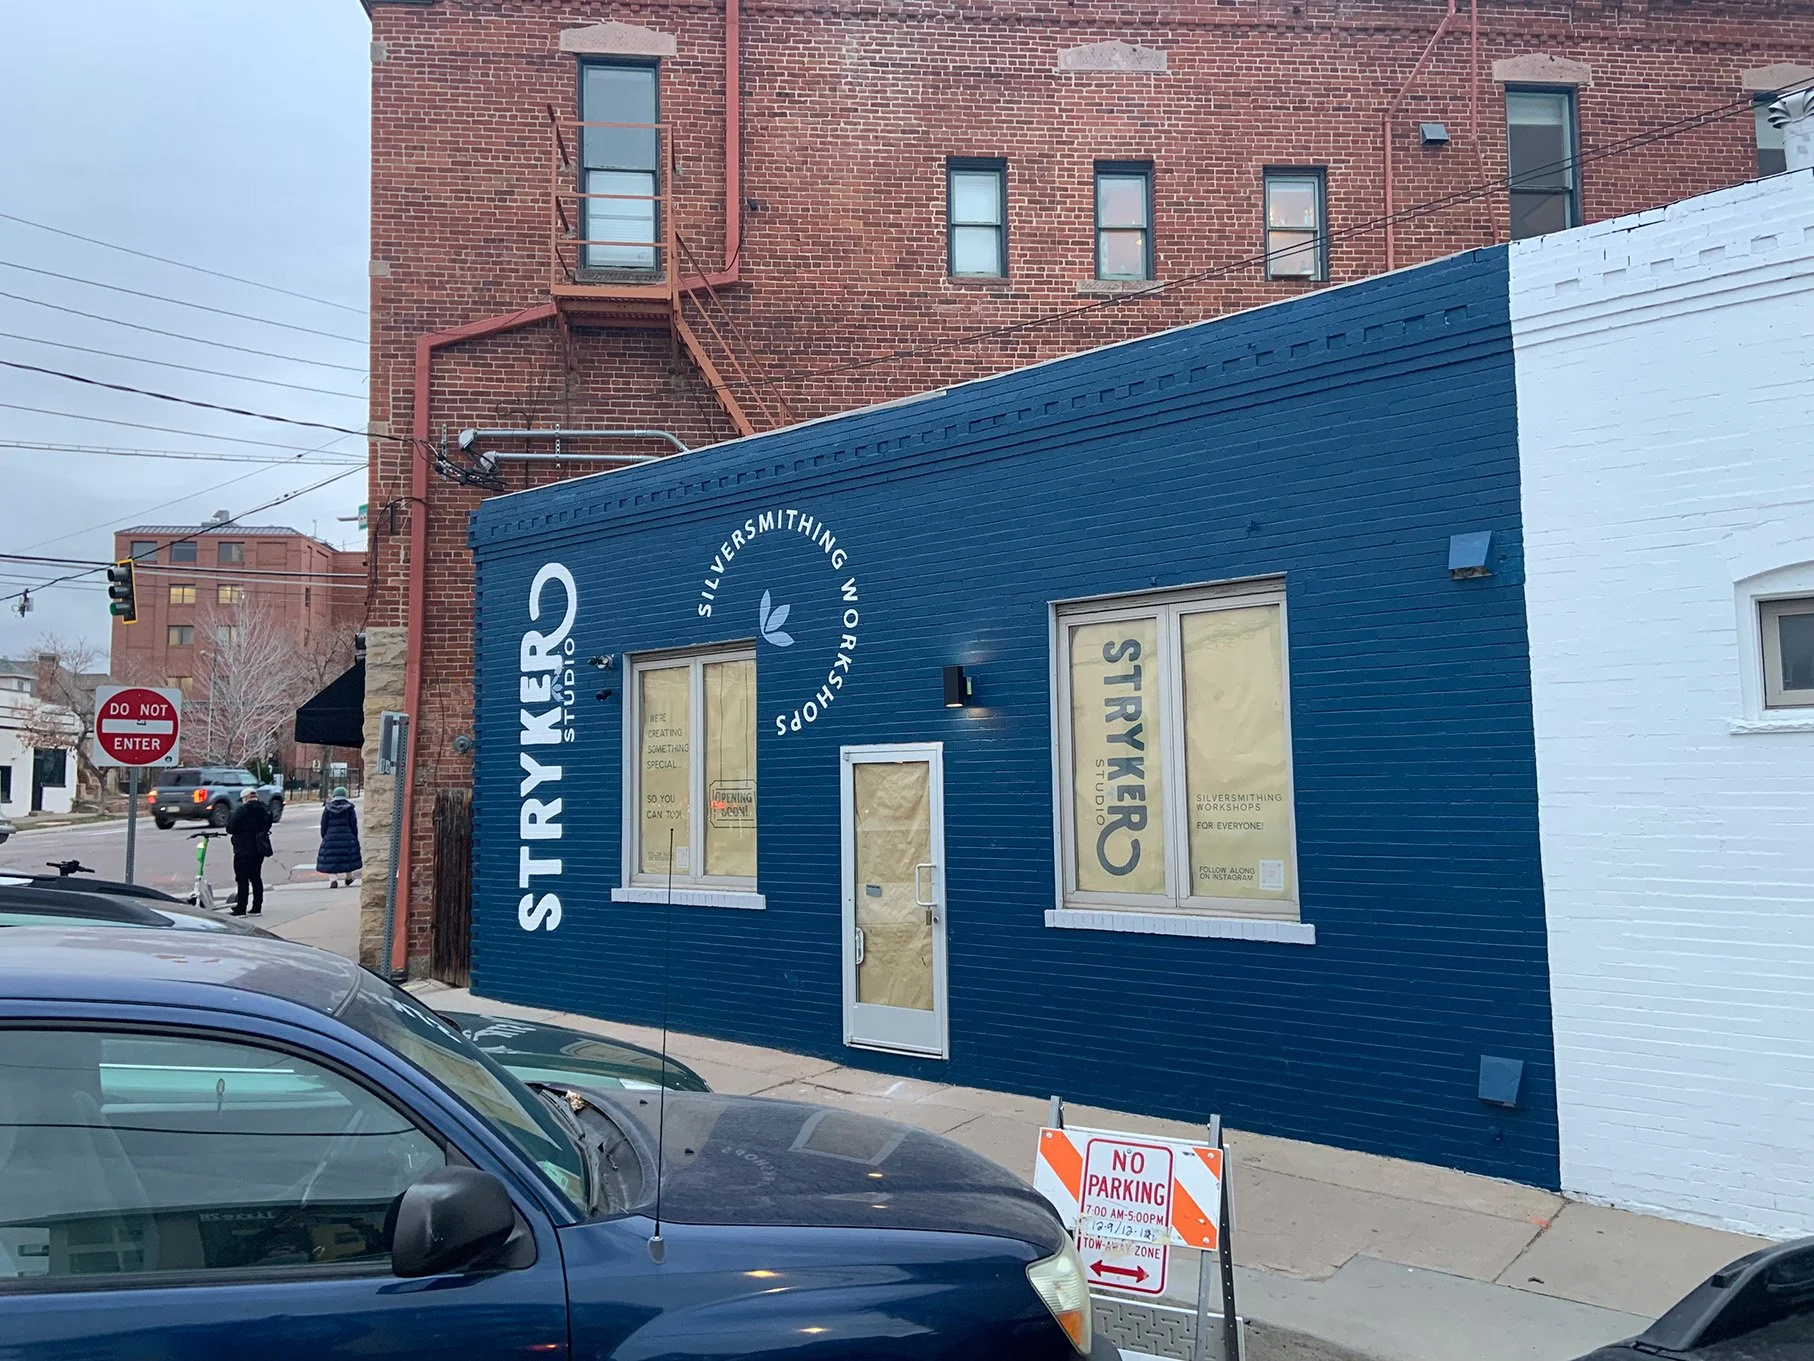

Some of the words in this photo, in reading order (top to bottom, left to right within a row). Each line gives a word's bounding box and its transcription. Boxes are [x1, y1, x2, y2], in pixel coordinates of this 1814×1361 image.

[698, 509, 848, 618] SILVERSMITHING
[775, 577, 859, 736] WORKSHOPS
[563, 638, 576, 743] STUDIO
[109, 702, 130, 716] DO
[140, 703, 169, 717] NOT
[647, 728, 683, 739] CREATING
[113, 737, 161, 751] ENTER
[518, 562, 577, 931] STRYKER
[647, 743, 690, 754] SOMETHING
[1095, 638, 1148, 877] STRYKER
[646, 794, 658, 804] SO
[660, 794, 676, 804] YOU
[715, 791, 753, 804] OPENING
[1095, 758, 1105, 826] STUDIO
[1196, 793, 1283, 802] SILVERSMITHING
[646, 809, 663, 820] CAN
[1196, 803, 1261, 812] WORKSHOPS
[1196, 821, 1213, 830] FOR
[1216, 821, 1264, 831] EVERYONE!
[1199, 866, 1227, 874] FOLLOW
[1229, 867, 1256, 875] ALONG
[1212, 873, 1254, 881] INSTAGRAM
[1112, 1149, 1145, 1175] NO
[1087, 1174, 1166, 1207] PARKING
[1086, 1204, 1107, 1218] 7:00
[1134, 1245, 1161, 1260] ZONE
